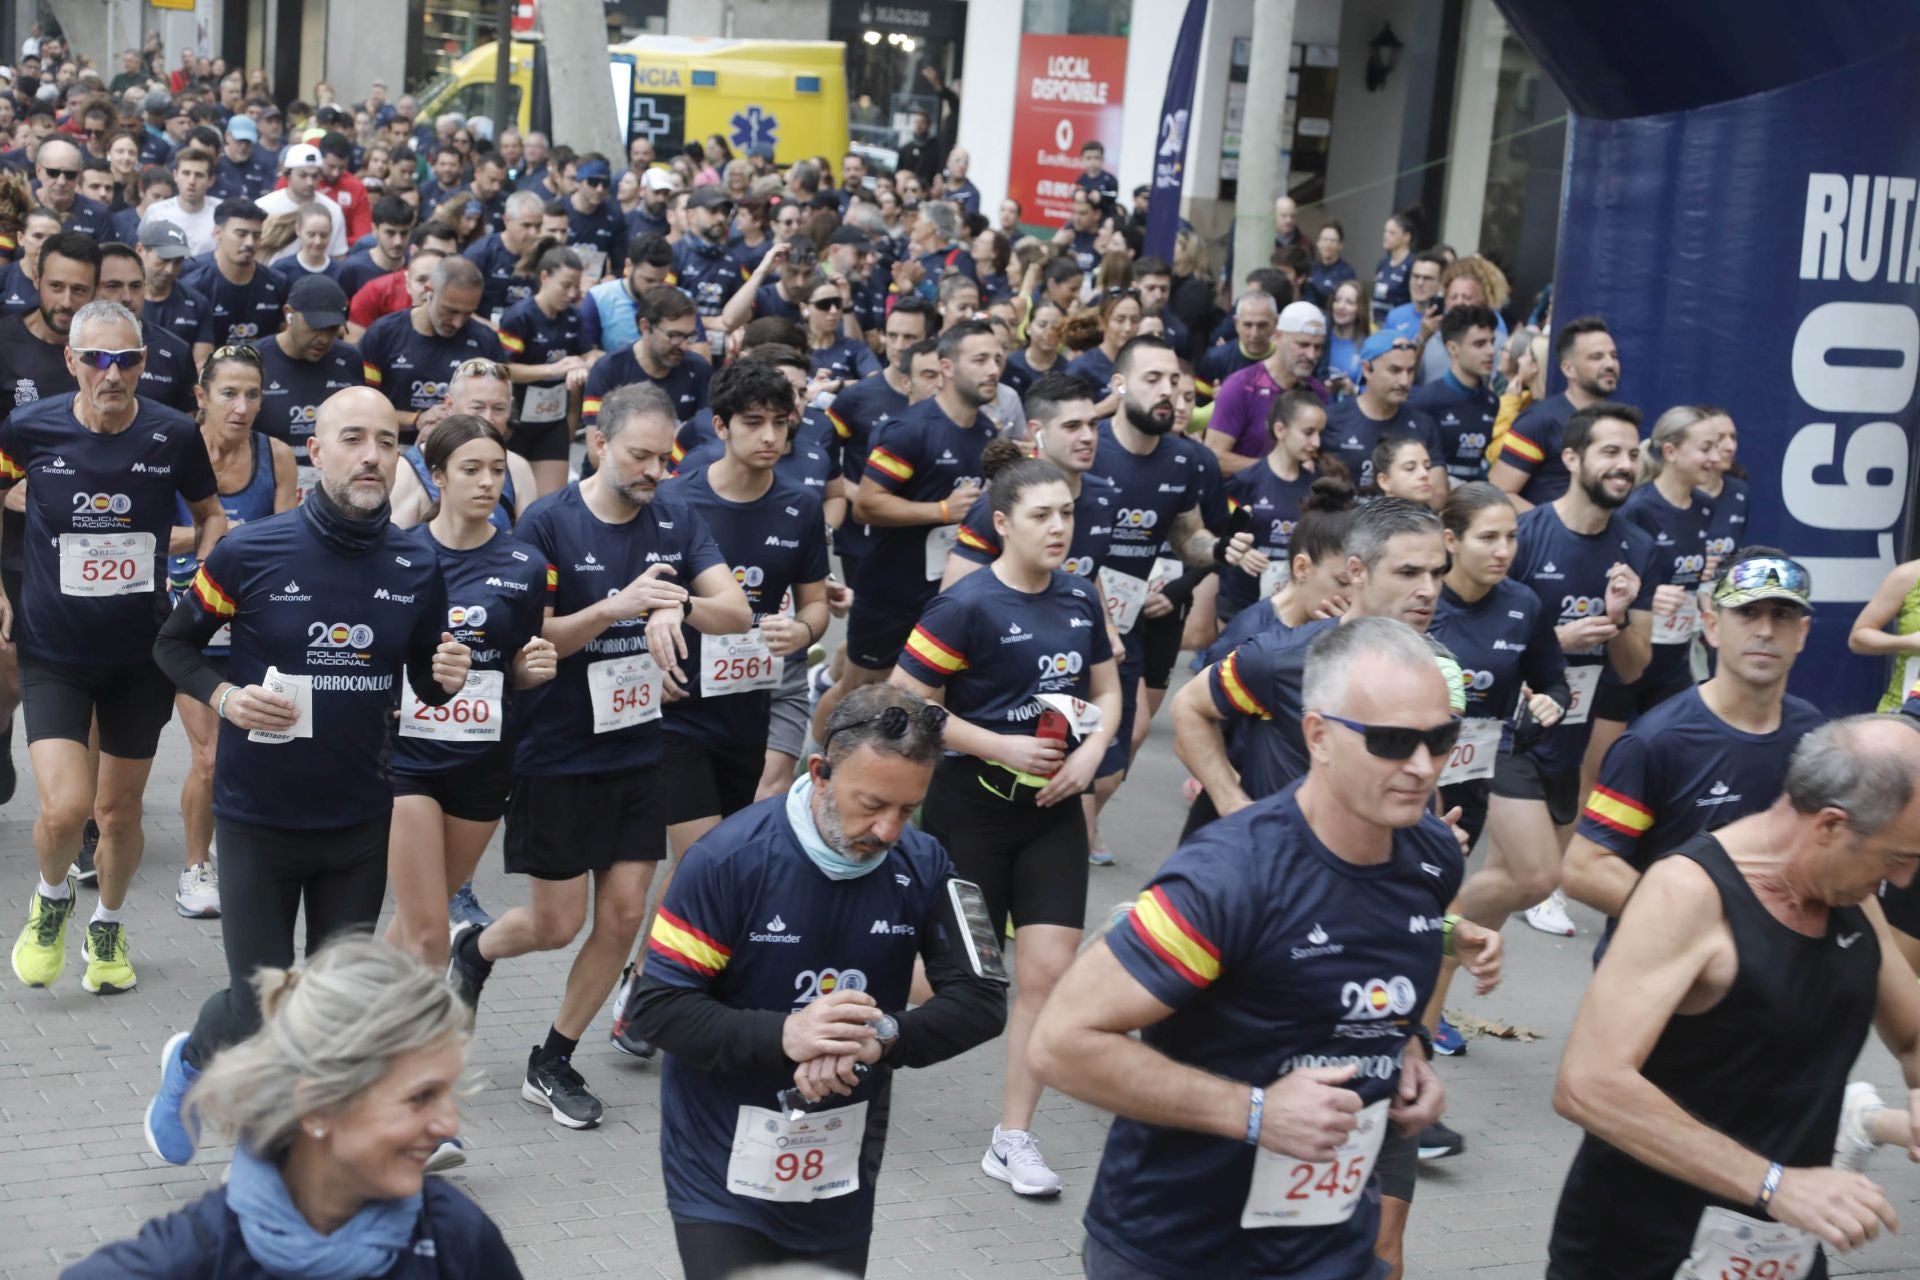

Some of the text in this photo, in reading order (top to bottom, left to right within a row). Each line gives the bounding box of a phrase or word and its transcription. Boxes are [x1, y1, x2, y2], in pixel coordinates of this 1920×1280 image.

[1048, 56, 1091, 80] LOCAL
[1031, 78, 1108, 104] DISPONIBLE
[42, 465, 76, 475] Santander
[148, 465, 171, 474] mupol
[73, 492, 131, 514] 200
[1117, 508, 1158, 528] 200
[82, 559, 136, 581] 520
[1674, 554, 1704, 574] 200
[504, 580, 528, 591] mupol
[269, 593, 312, 602] Santander
[392, 594, 415, 604] mupol
[1560, 595, 1605, 617] 200
[307, 621, 374, 650] 200
[1000, 633, 1033, 644] Santander
[307, 651, 358, 659] POLICIA
[307, 658, 371, 666] NACIONAL
[1038, 651, 1083, 679] 200
[714, 656, 773, 681] 2561
[613, 684, 651, 714] 543
[414, 699, 490, 723] 2560
[749, 932, 801, 944] Santander
[793, 968, 868, 1004] 200
[1341, 975, 1417, 1020] 200
[774, 1149, 825, 1182] 98
[1286, 1156, 1366, 1200] 245
